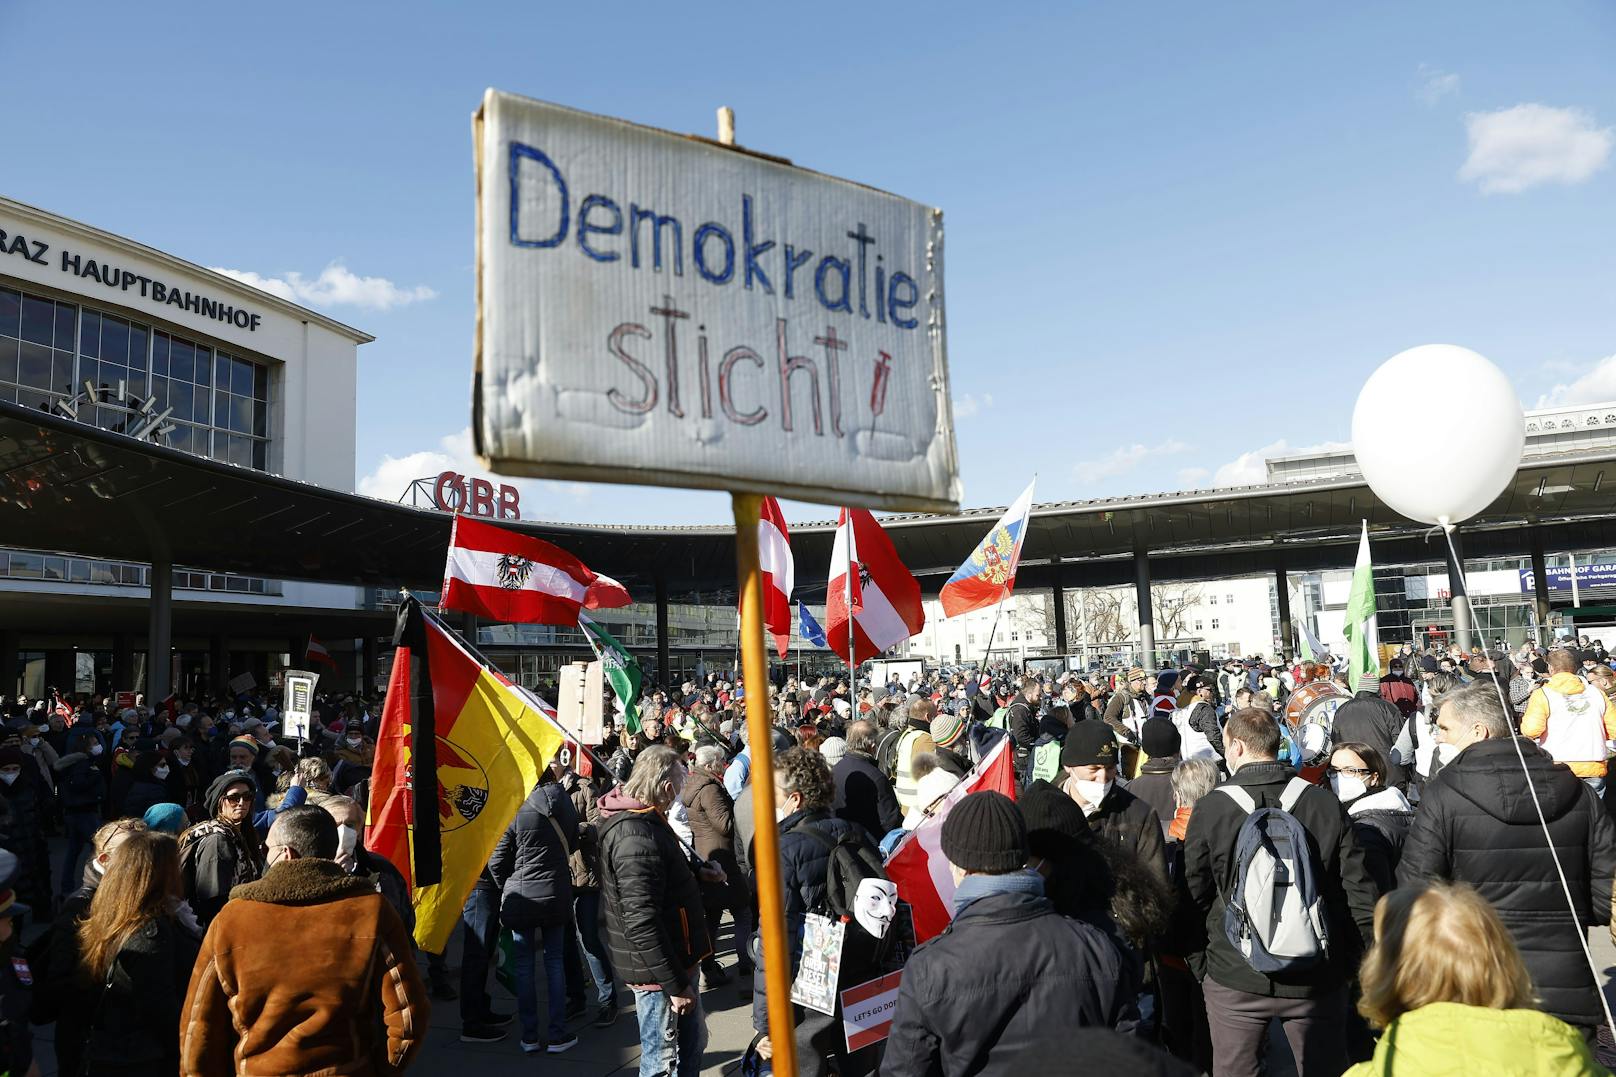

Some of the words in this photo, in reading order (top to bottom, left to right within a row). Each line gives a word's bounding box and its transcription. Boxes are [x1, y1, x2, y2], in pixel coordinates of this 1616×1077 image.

[509, 140, 919, 330] Demokratie
[62, 250, 262, 331] HAUPTBAHNHOF
[803, 968, 826, 986] RESET
[854, 1010, 872, 1022] LET'S
[872, 1006, 883, 1015] GO
